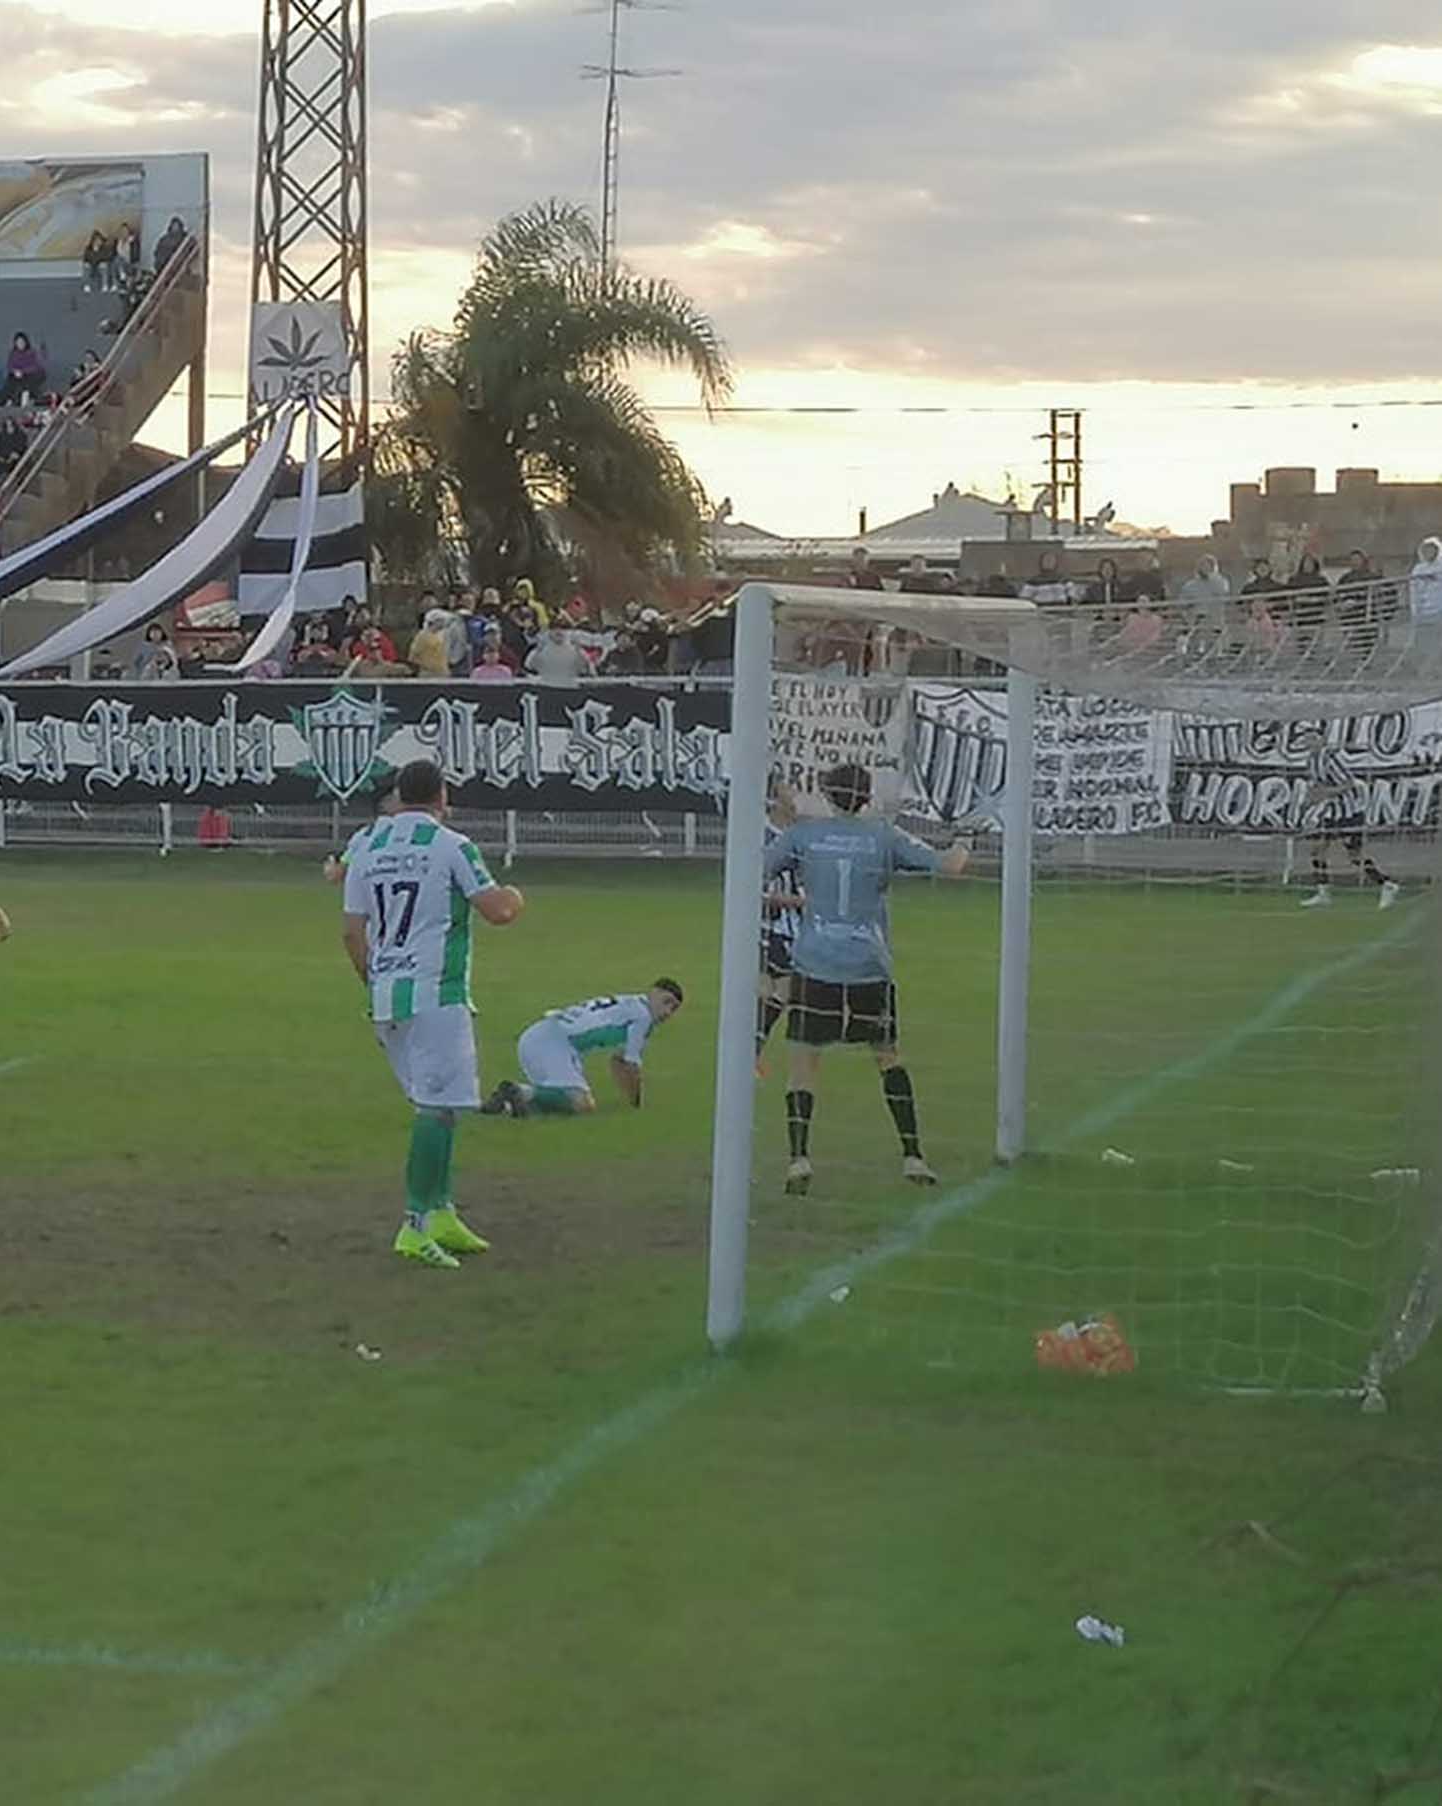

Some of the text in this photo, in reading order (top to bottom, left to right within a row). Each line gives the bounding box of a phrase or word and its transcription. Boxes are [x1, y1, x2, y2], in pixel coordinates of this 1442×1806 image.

[78, 690, 276, 796] Banda
[372, 880, 420, 949] 17
[837, 857, 852, 918] 1
